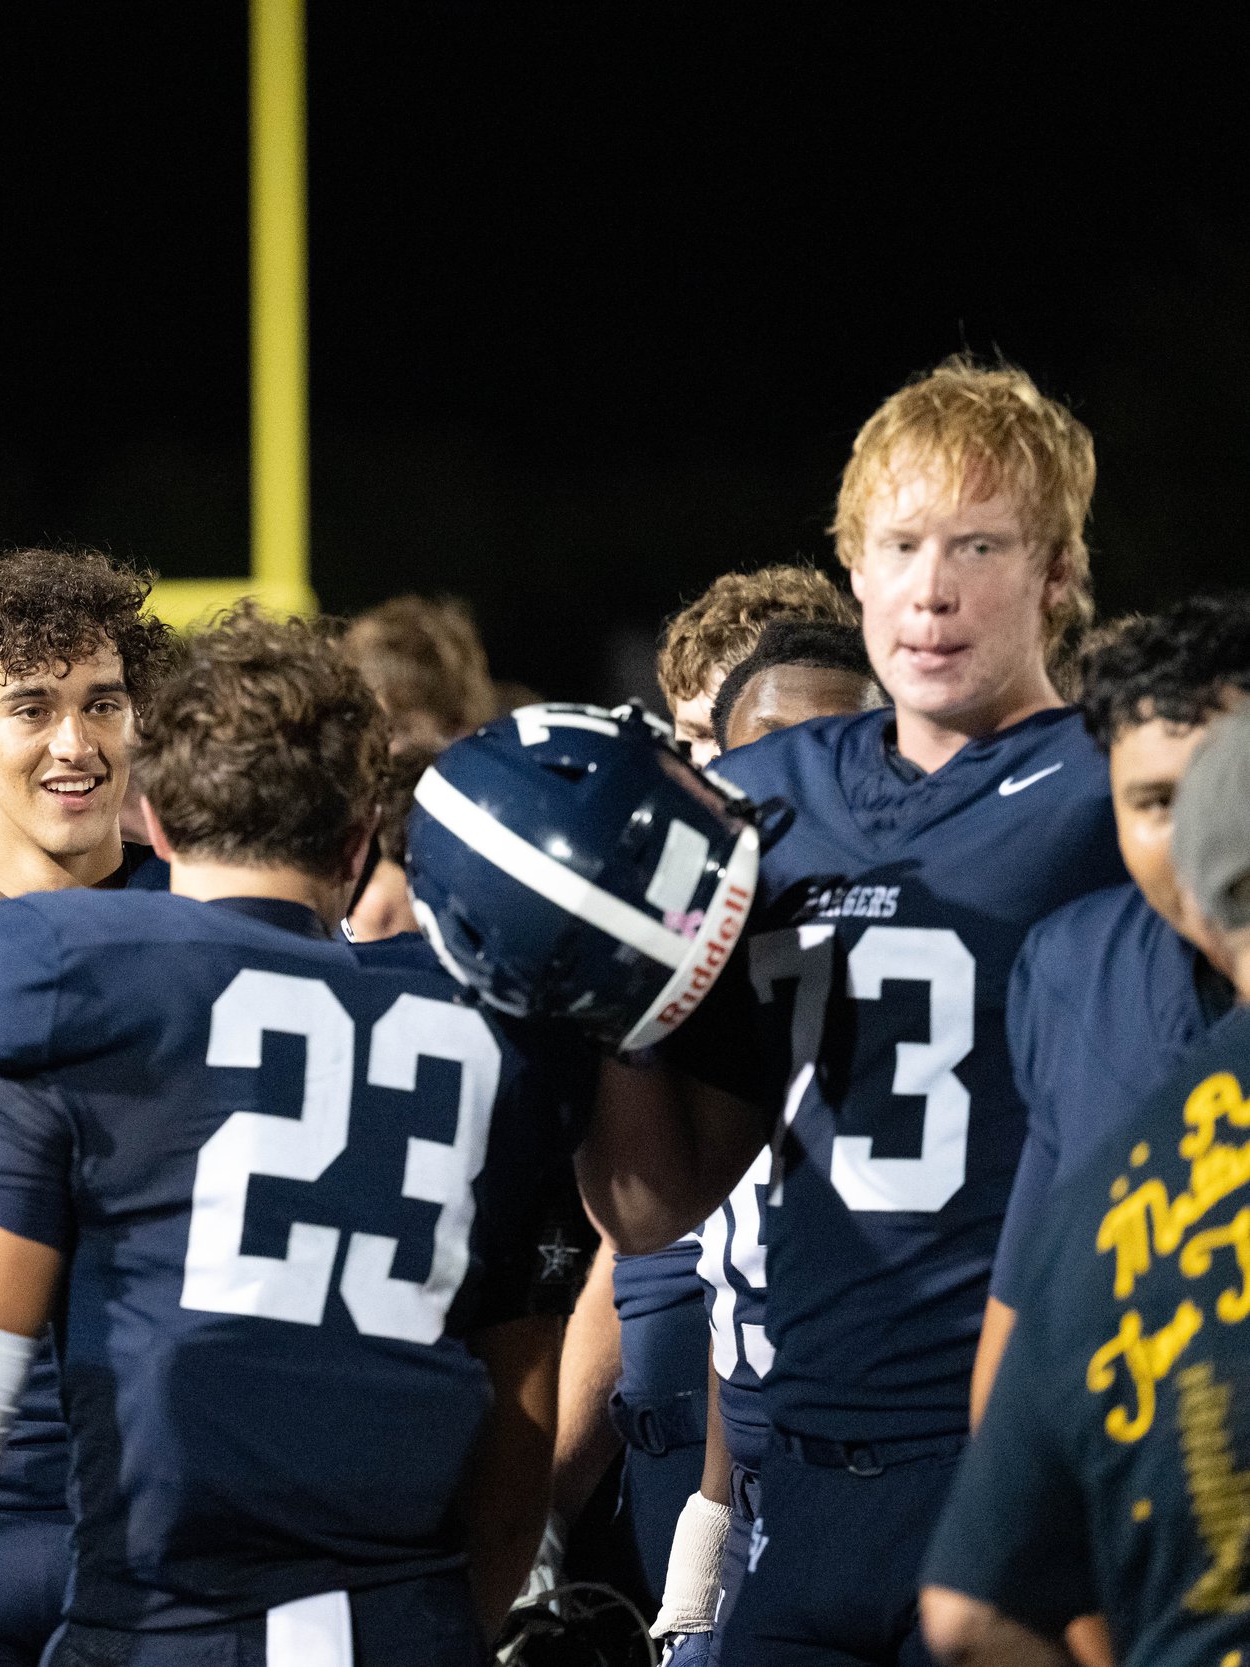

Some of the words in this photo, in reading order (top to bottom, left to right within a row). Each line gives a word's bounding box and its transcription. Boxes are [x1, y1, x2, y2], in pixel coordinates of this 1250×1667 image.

[658, 885, 749, 1026] Riddell
[748, 925, 976, 1212] 73
[179, 967, 502, 1345] 23
